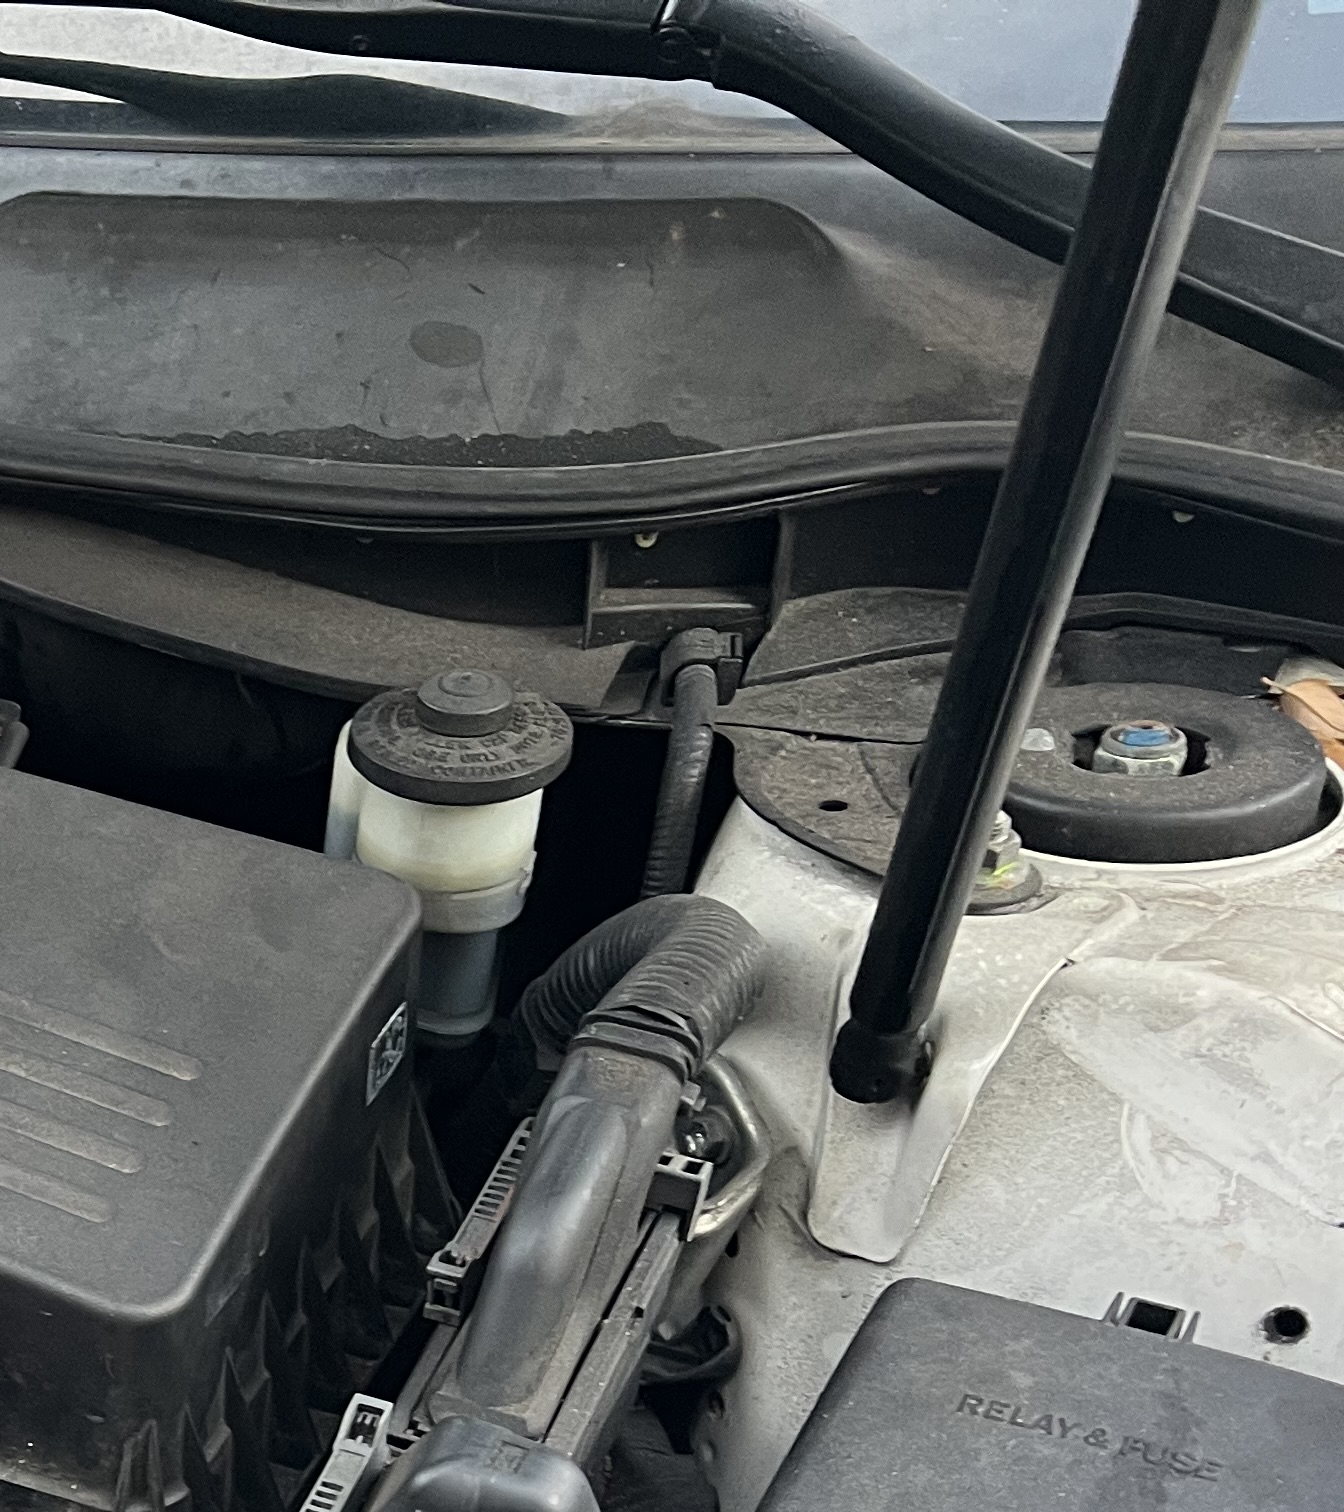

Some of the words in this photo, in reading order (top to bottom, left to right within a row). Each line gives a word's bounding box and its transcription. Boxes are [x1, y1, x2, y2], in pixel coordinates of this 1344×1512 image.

[955, 1394, 1081, 1439] RELAY
[1083, 1428, 1109, 1450] &
[1119, 1435, 1226, 1481] FUSE
